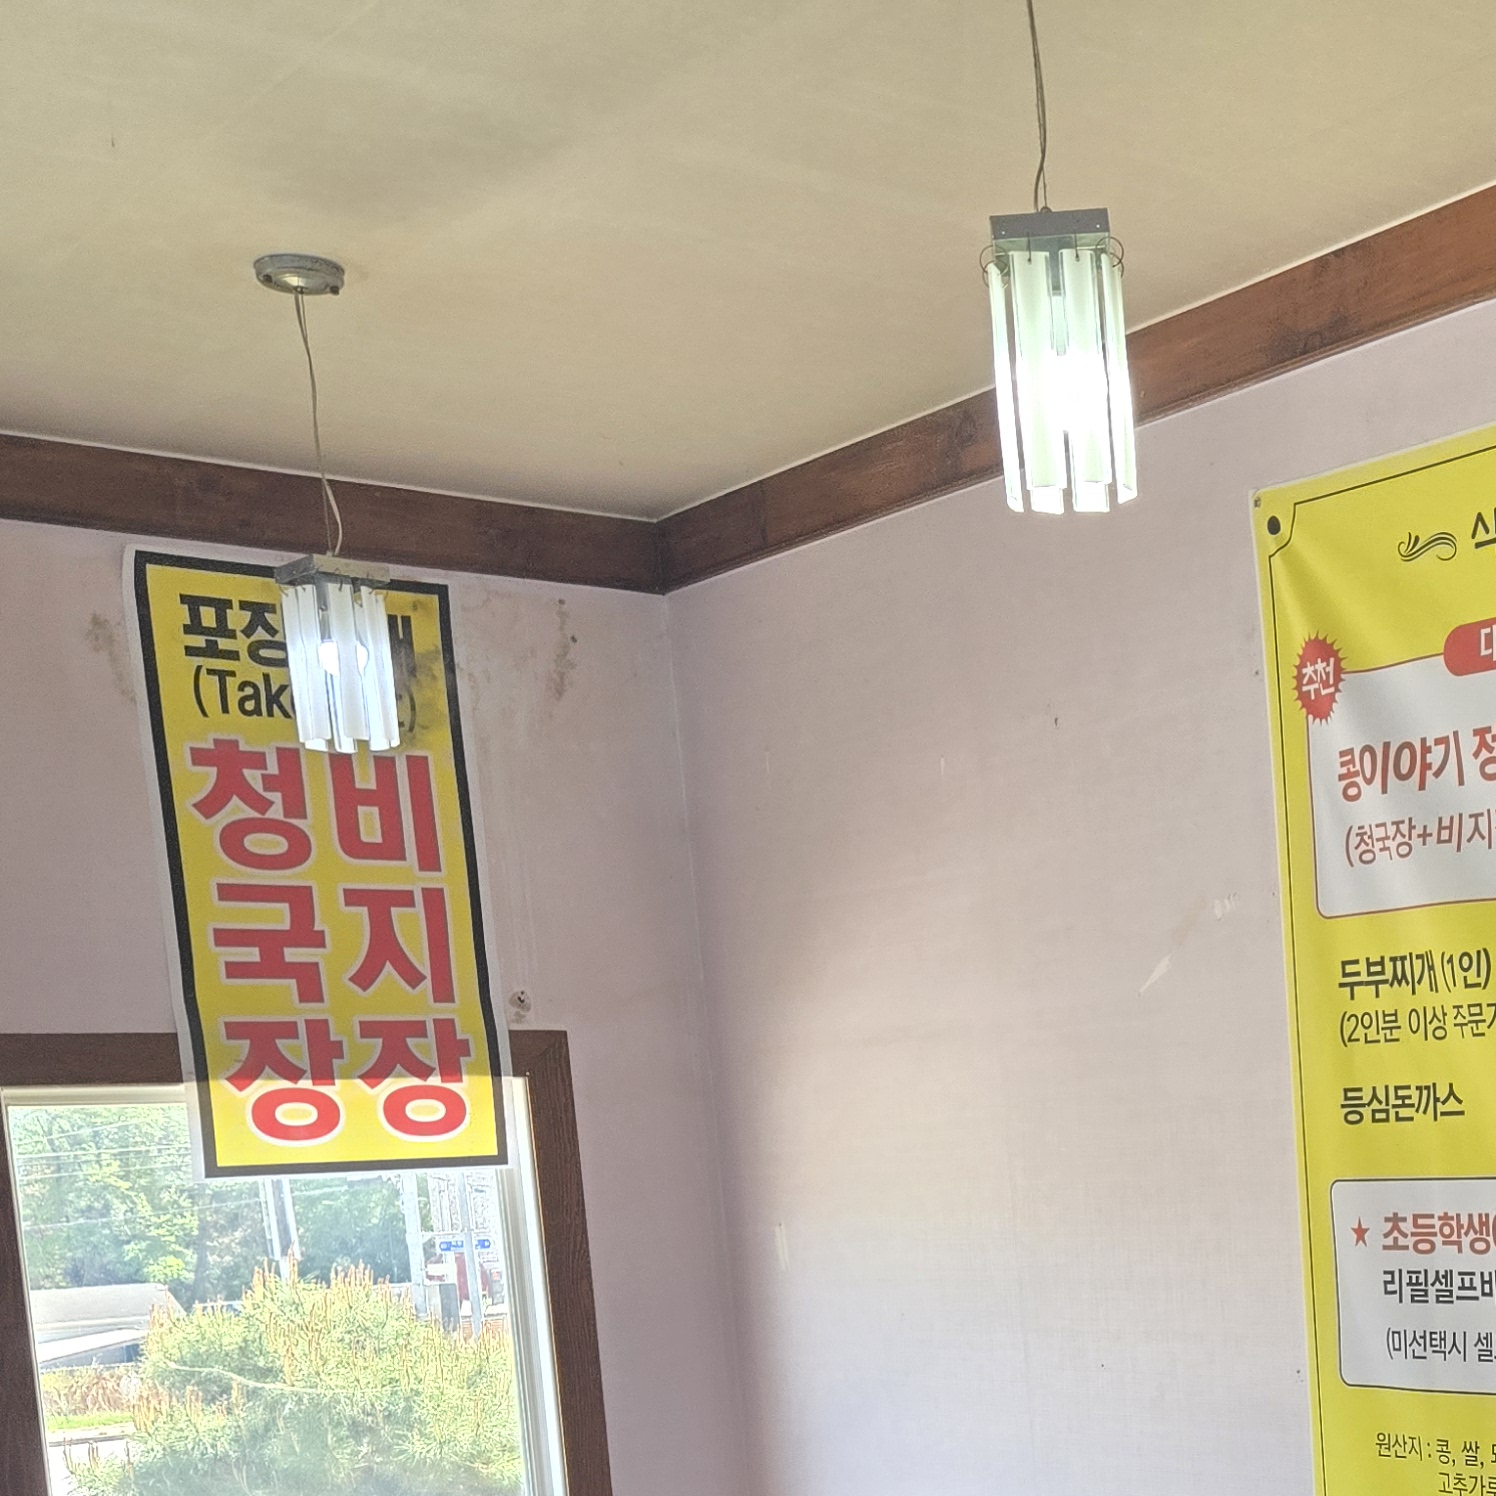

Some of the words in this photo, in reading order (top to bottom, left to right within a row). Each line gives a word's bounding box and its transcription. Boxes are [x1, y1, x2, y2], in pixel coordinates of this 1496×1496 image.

[1301, 657, 1336, 700] 추천
[1338, 729, 1465, 802] 콩이야기
[1340, 1009, 1401, 1047] (2인분
[1408, 1005, 1447, 1041] 이상
[1341, 1082, 1465, 1125] 등심돈까스
[1386, 1327, 1466, 1362] (미선택시
